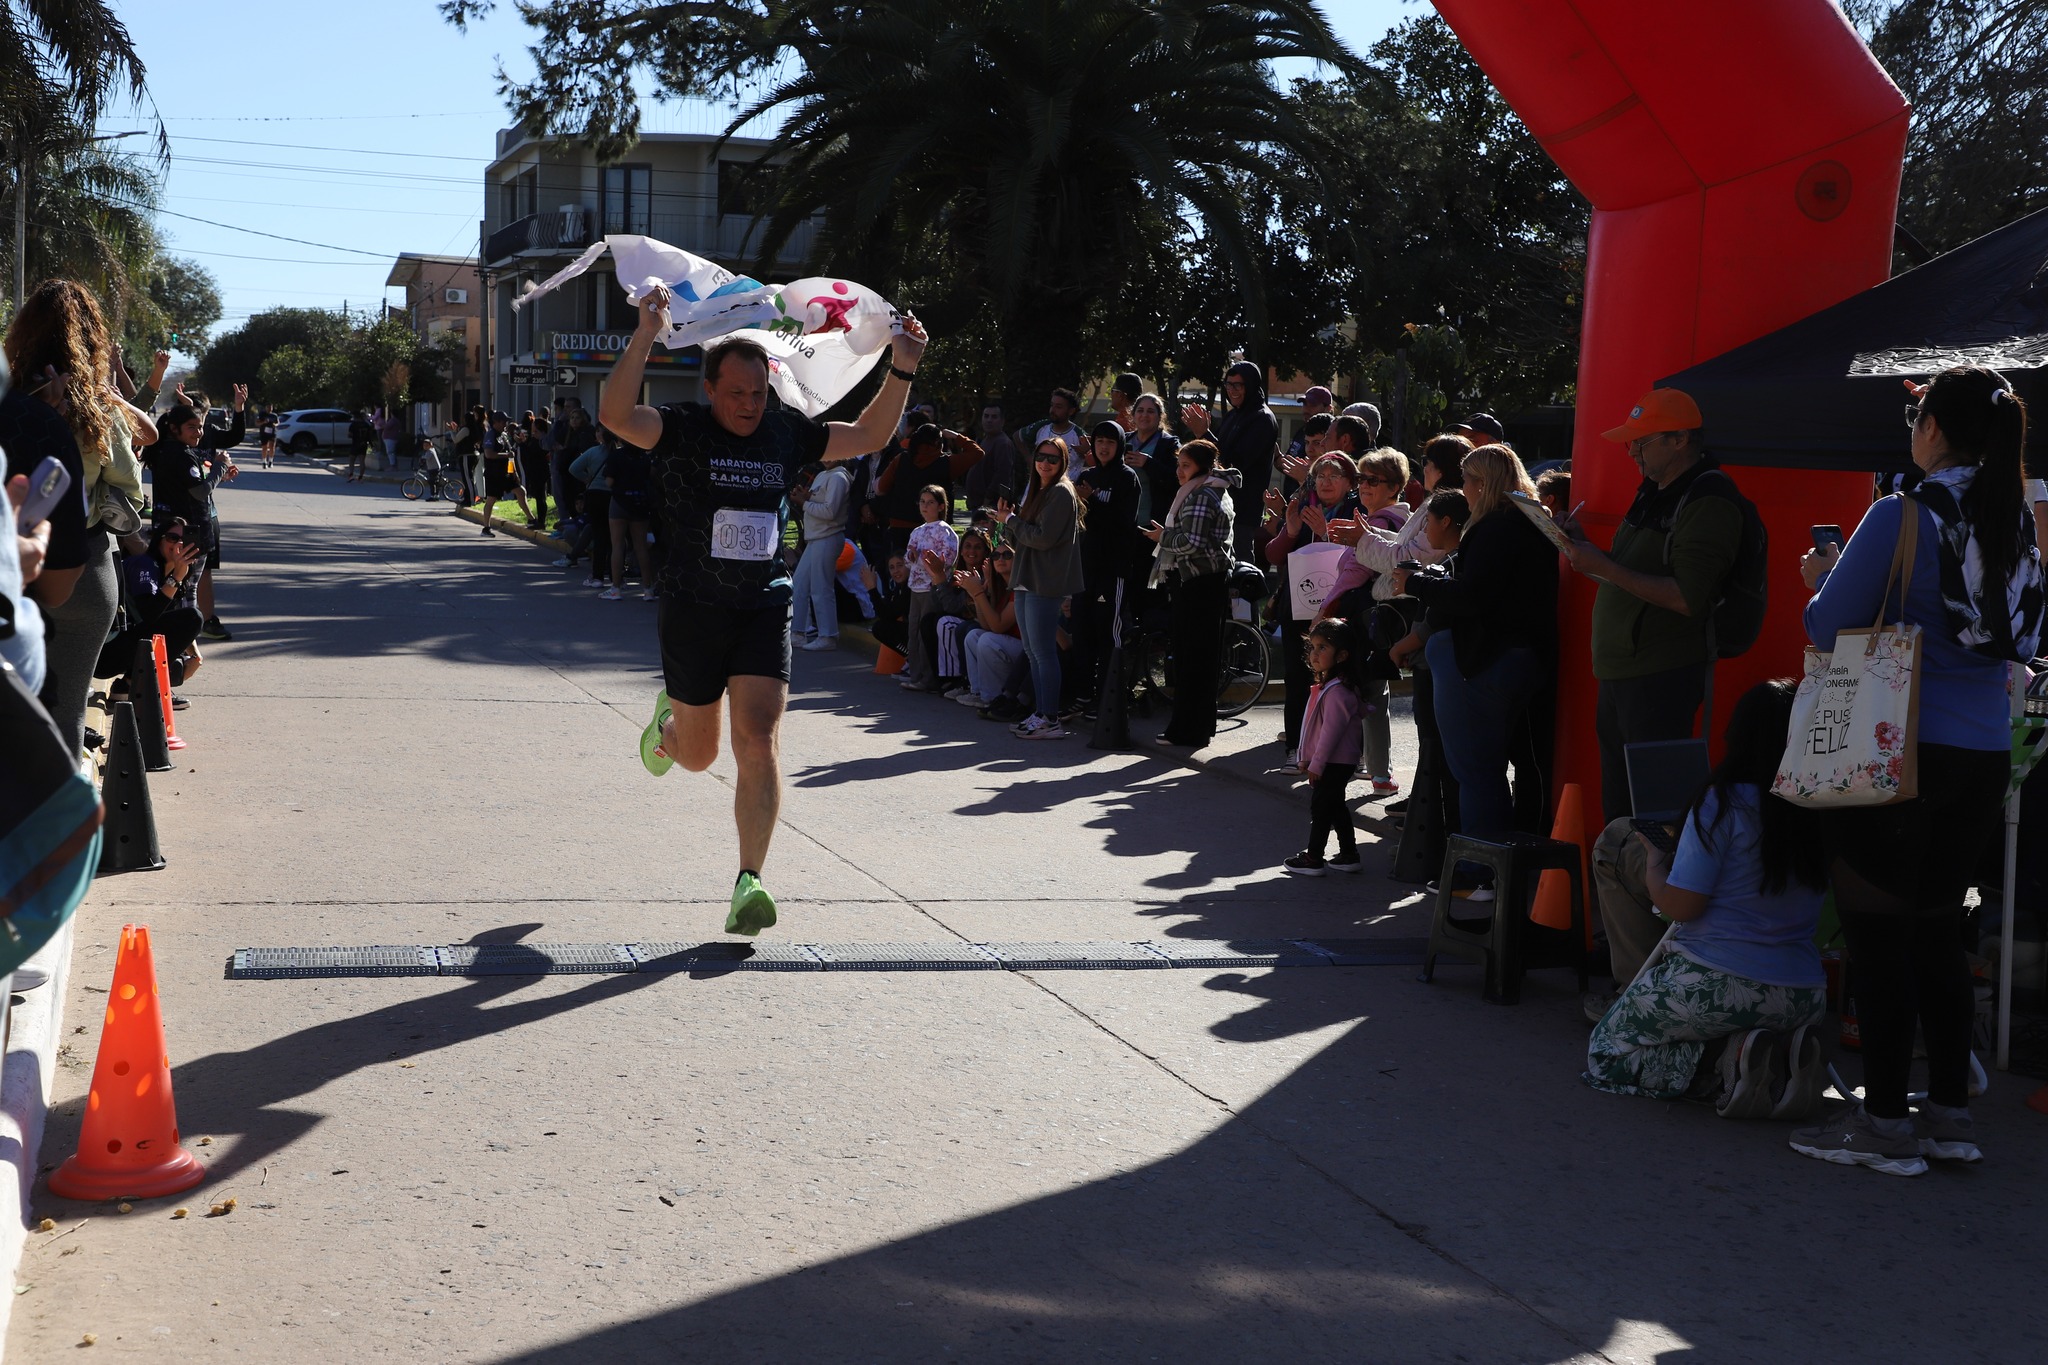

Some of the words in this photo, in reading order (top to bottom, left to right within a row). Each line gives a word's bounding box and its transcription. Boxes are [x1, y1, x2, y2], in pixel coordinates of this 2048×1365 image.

[515, 367, 543, 375] Maipú
[513, 376, 527, 384] 2200
[709, 458, 761, 470] MARATON
[762, 462, 784, 485] 82
[720, 524, 767, 551] 031
[1828, 666, 1849, 676] SABÍA
[1825, 678, 1860, 688] ONERME
[1804, 722, 1850, 756] FELIZ
